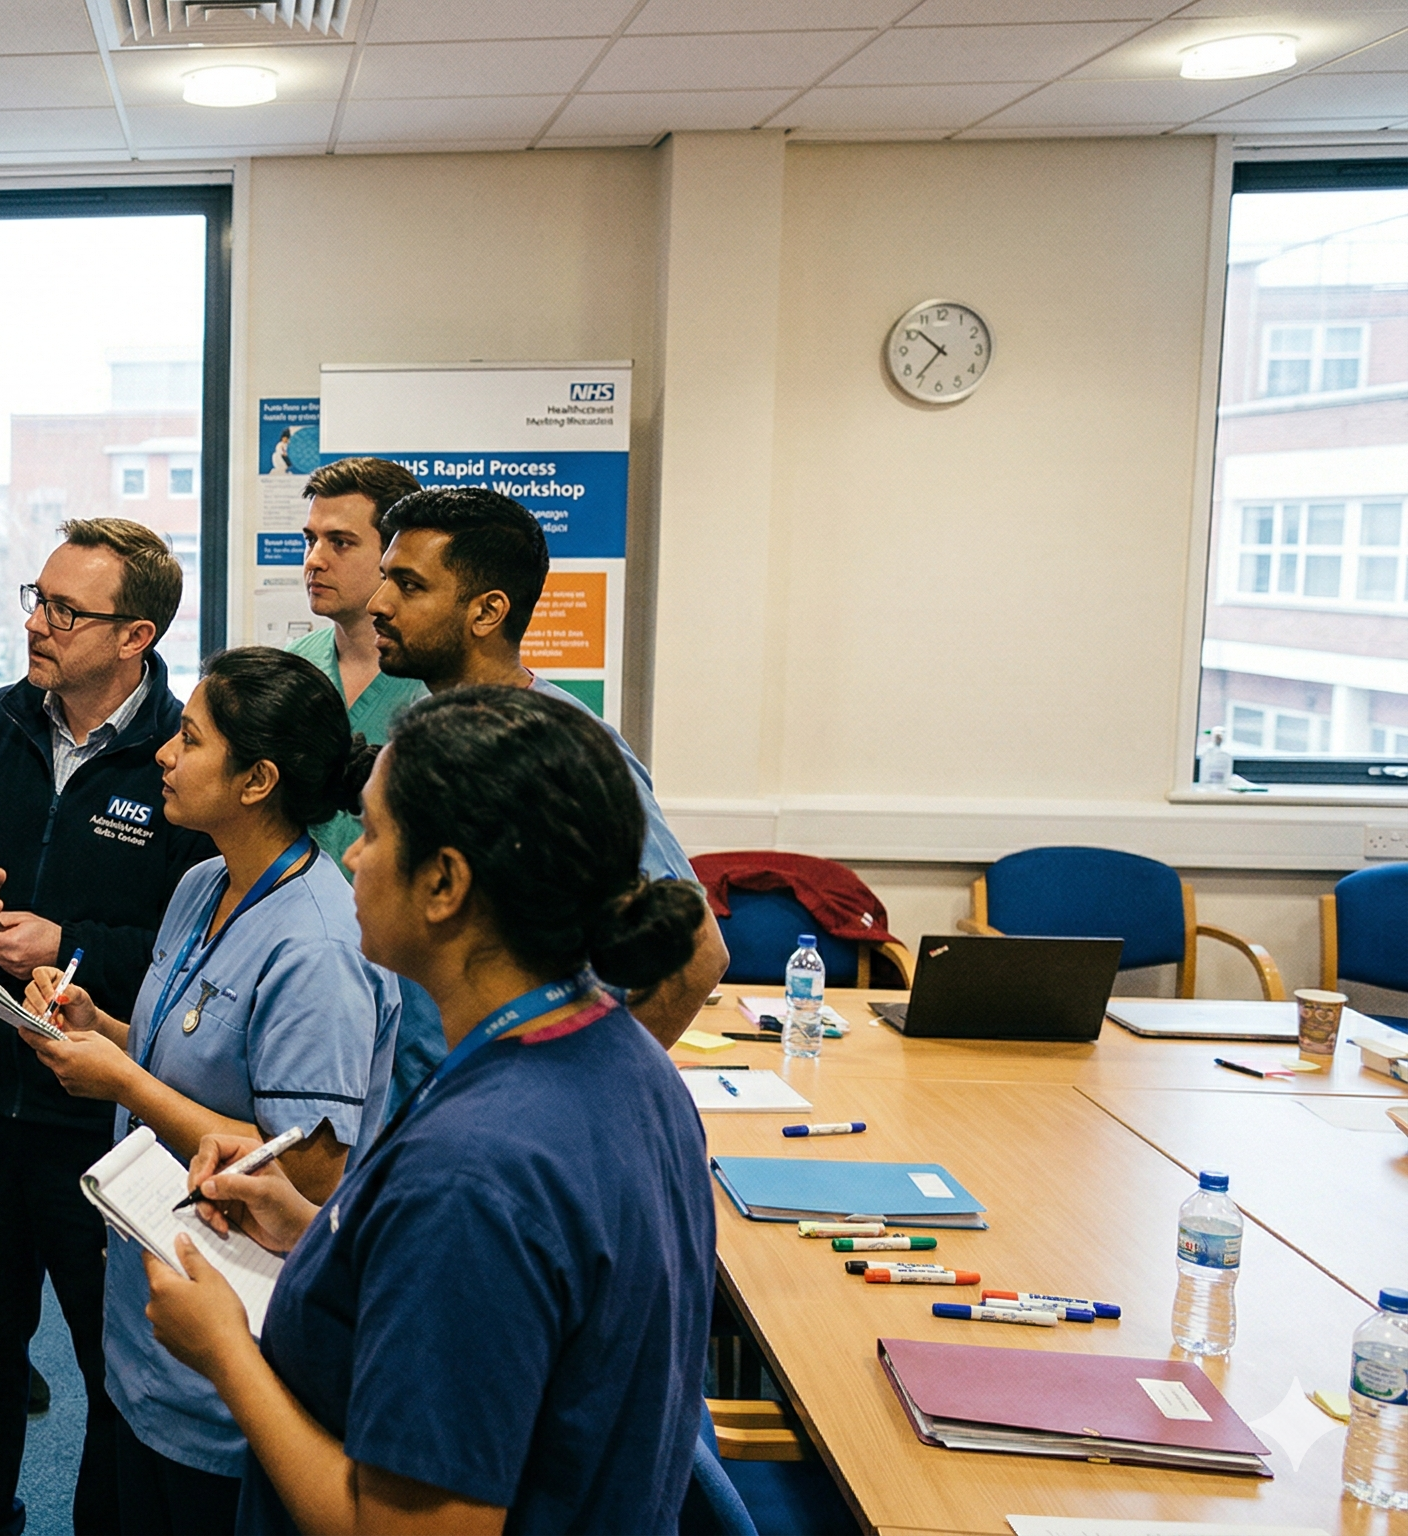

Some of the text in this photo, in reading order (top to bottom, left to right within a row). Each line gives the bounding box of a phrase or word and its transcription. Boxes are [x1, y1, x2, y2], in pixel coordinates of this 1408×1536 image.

[920, 314, 929, 325] 11
[937, 308, 949, 321] 12
[904, 328, 919, 342] 10
[969, 326, 979, 339] 2
[899, 345, 909, 357] 9
[974, 343, 983, 356] 3
[903, 363, 912, 377] 8
[967, 363, 975, 374] 4
[934, 380, 943, 392] 6
[953, 375, 962, 388] 5
[571, 384, 614, 400] NHS
[433, 459, 485, 479] Rapid
[490, 459, 557, 477] Process
[493, 480, 586, 500] Workshop
[107, 798, 151, 823] NHS
